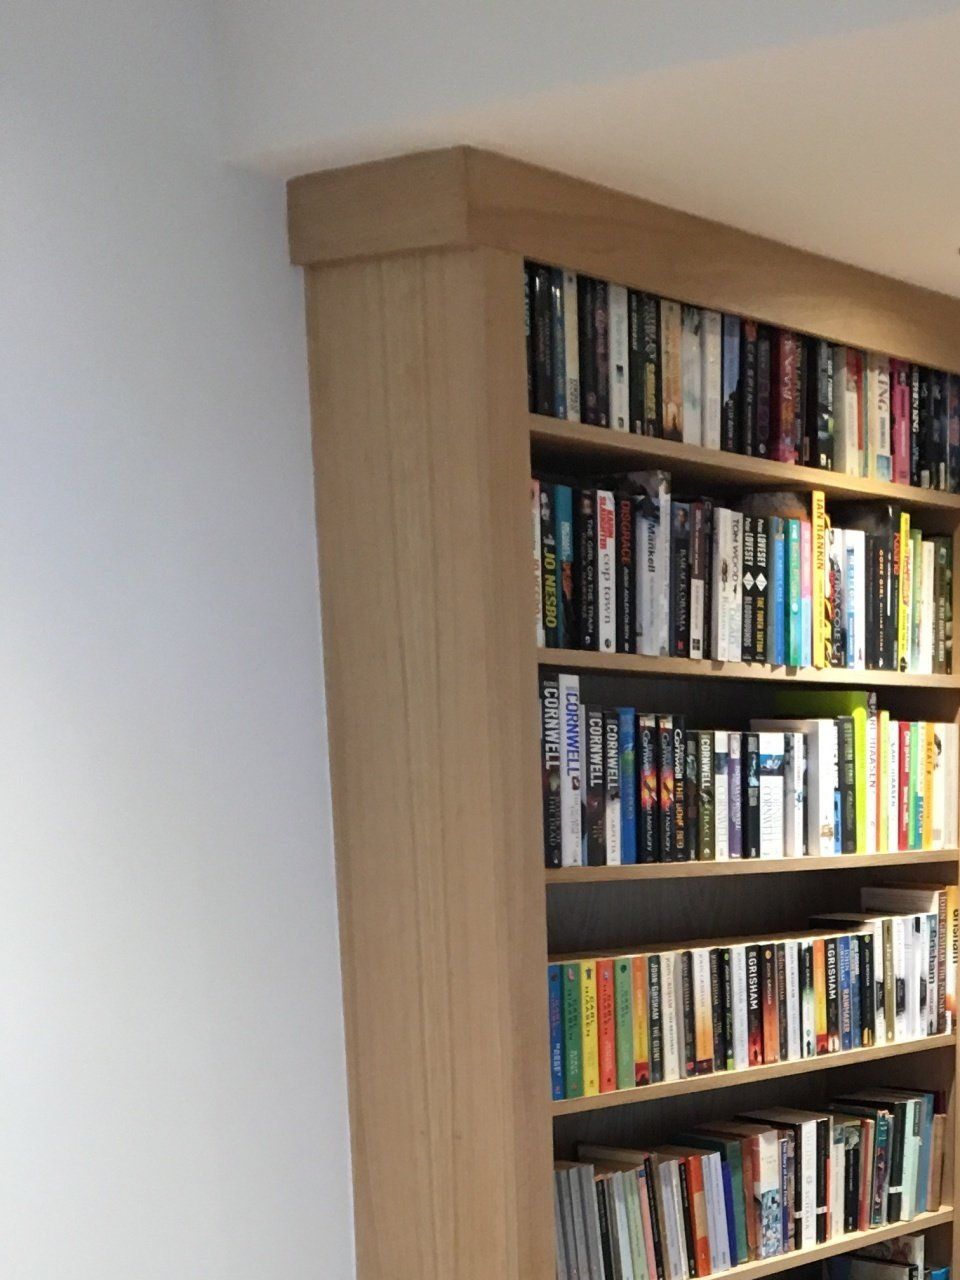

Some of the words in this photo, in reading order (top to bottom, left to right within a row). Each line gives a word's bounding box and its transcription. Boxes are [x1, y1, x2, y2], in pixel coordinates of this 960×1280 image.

[599, 496, 607, 550] SLAUGHTER
[620, 500, 631, 566] DISGRACE
[731, 519, 740, 543] TOM
[816, 498, 824, 520] IAN
[601, 553, 612, 582] cop
[646, 522, 657, 573] Mankell
[731, 545, 741, 583] WOOD
[744, 532, 754, 567] LOVESEY
[756, 533, 767, 568] LOVESEY
[816, 523, 824, 571] RANKIN
[545, 575, 558, 628] NESBO
[604, 586, 612, 625] town
[743, 596, 753, 648] BLOODHOUNDS
[833, 608, 841, 640] COLE
[544, 688, 560, 770] CORNWELL
[566, 692, 580, 777] CORNWELL
[589, 718, 603, 788] CORNWELL
[674, 728, 684, 779] Cornwell
[605, 724, 618, 791] CORNWELL
[701, 738, 711, 789] CORNWELL
[869, 737, 877, 788] HIAASEN
[827, 949, 836, 1000] GRISHAM
[928, 929, 937, 985] Grisham
[652, 986, 660, 1020] GRISHAM
[748, 958, 758, 1011] GRISHAM
[938, 982, 946, 1014] PARTNER
[842, 988, 850, 1034] RAINMAKER
